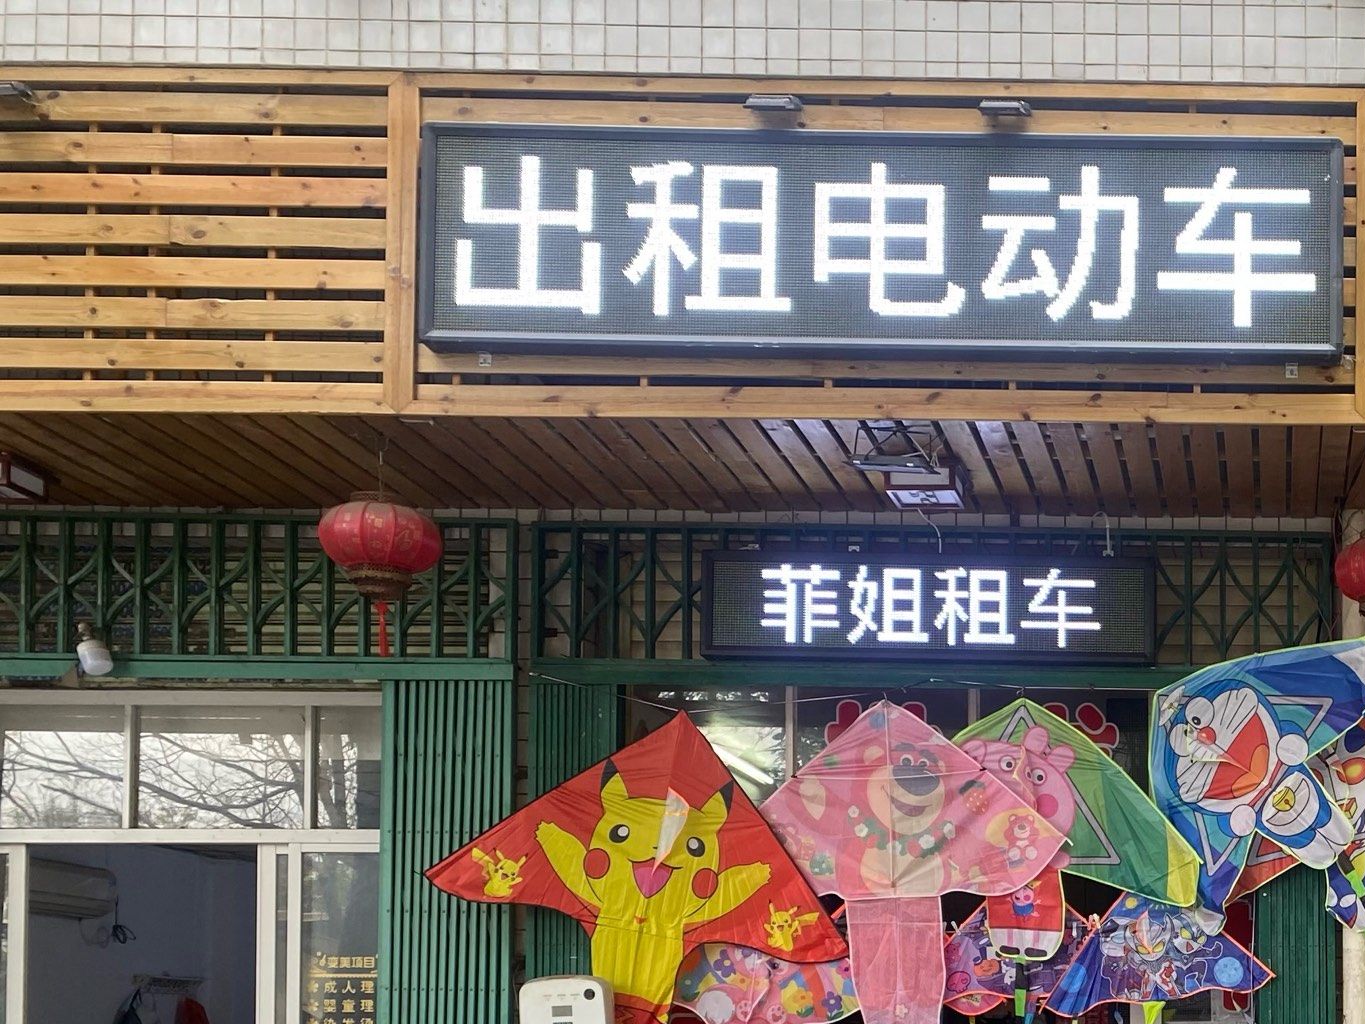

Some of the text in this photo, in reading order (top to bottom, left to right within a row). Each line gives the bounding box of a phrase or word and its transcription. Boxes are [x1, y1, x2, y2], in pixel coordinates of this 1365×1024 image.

[455, 155, 1316, 328] 出租电动车
[760, 564, 1101, 648] 菲姐租车
